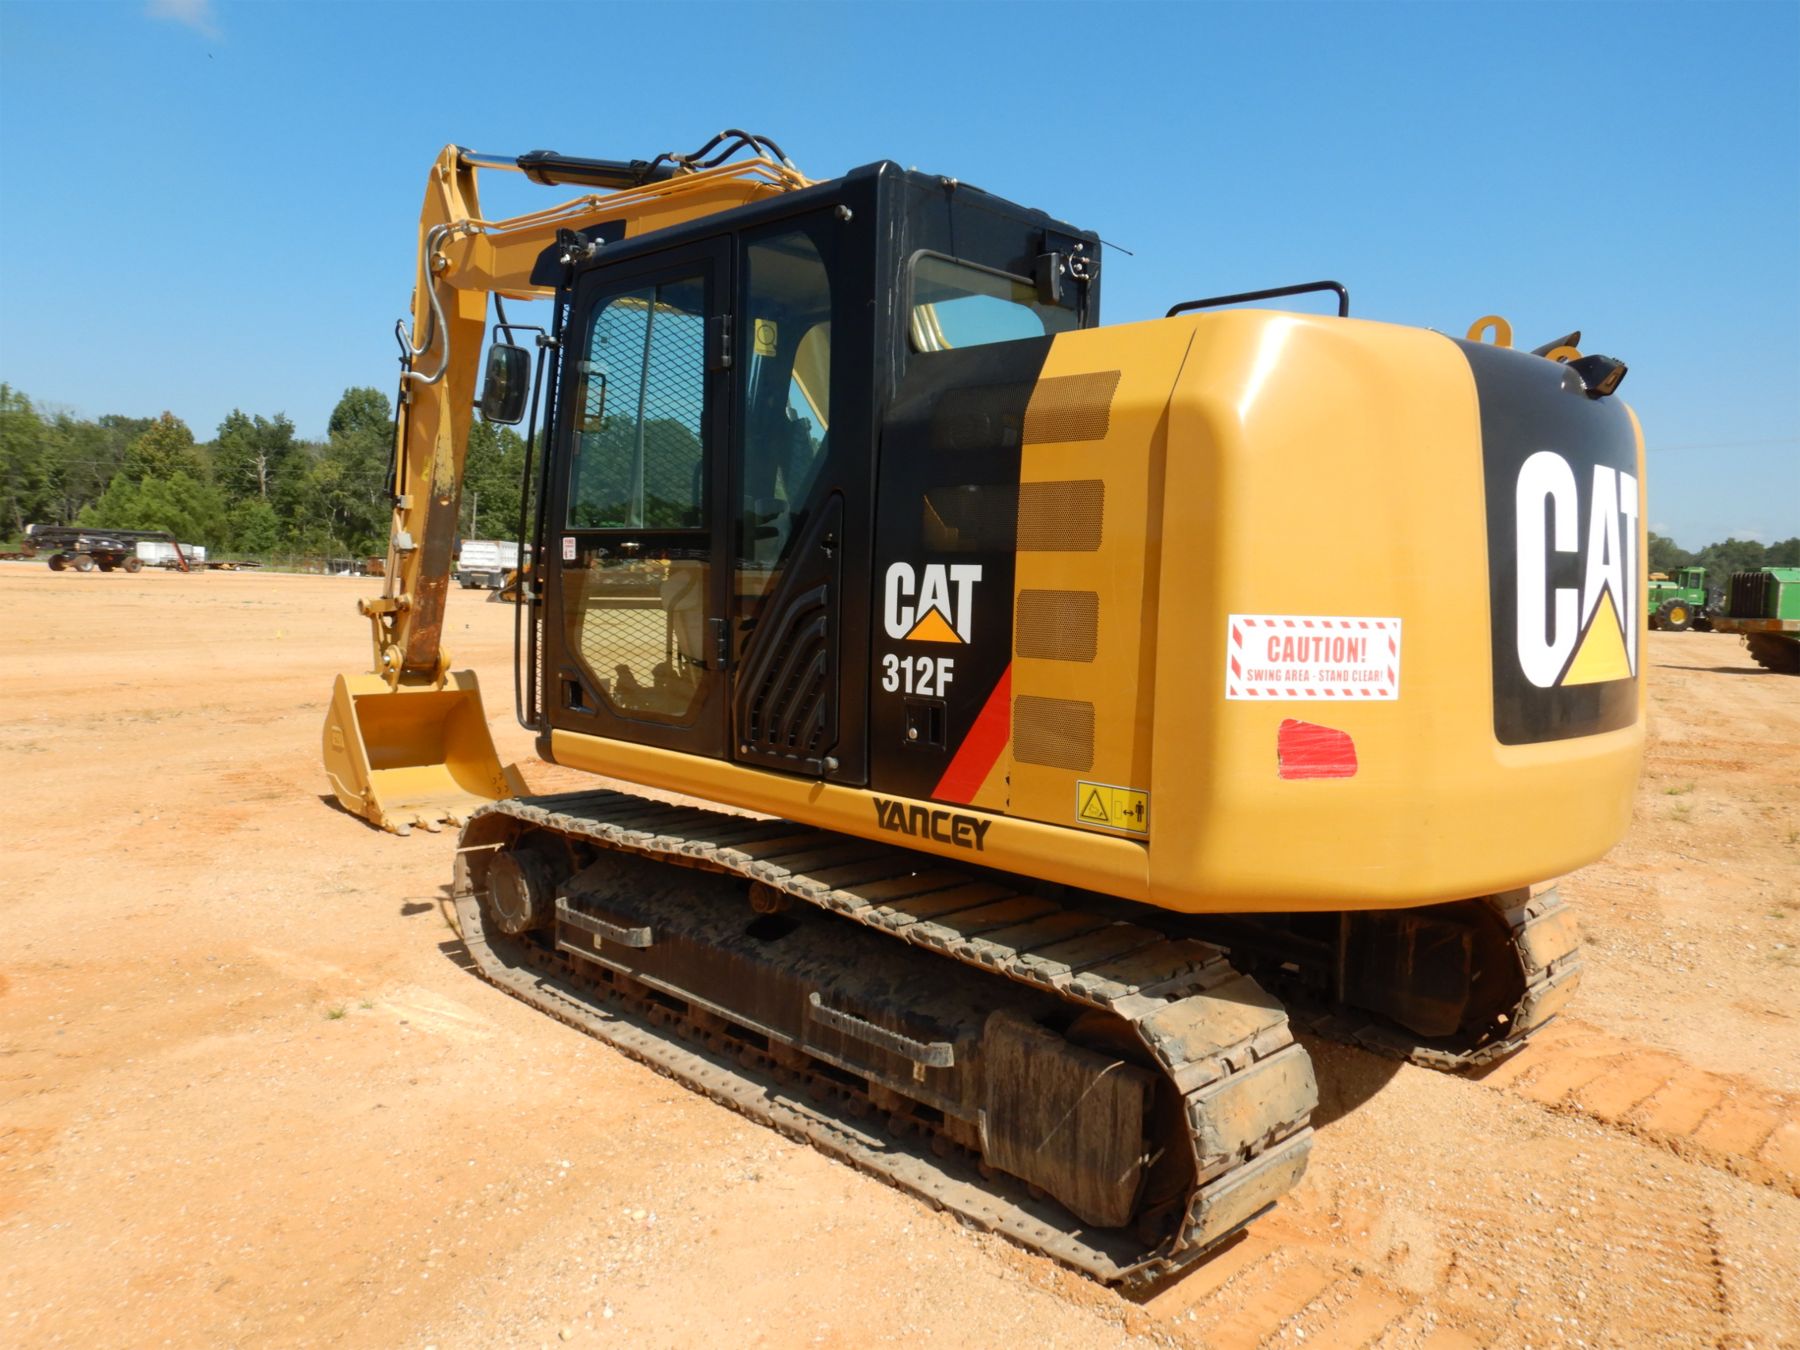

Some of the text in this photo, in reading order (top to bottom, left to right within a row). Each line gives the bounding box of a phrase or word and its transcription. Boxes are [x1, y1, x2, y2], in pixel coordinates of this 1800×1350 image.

[1516, 451, 1638, 688] CAT
[884, 561, 983, 644] CAT
[1267, 635, 1367, 663] CAUTION!
[882, 653, 954, 697] 312F
[1247, 669, 1282, 682] SWING
[1285, 669, 1310, 682] AREA
[1319, 669, 1349, 682] STAND
[1352, 670, 1383, 682] CLEAR!
[872, 797, 992, 851] YANCEY
